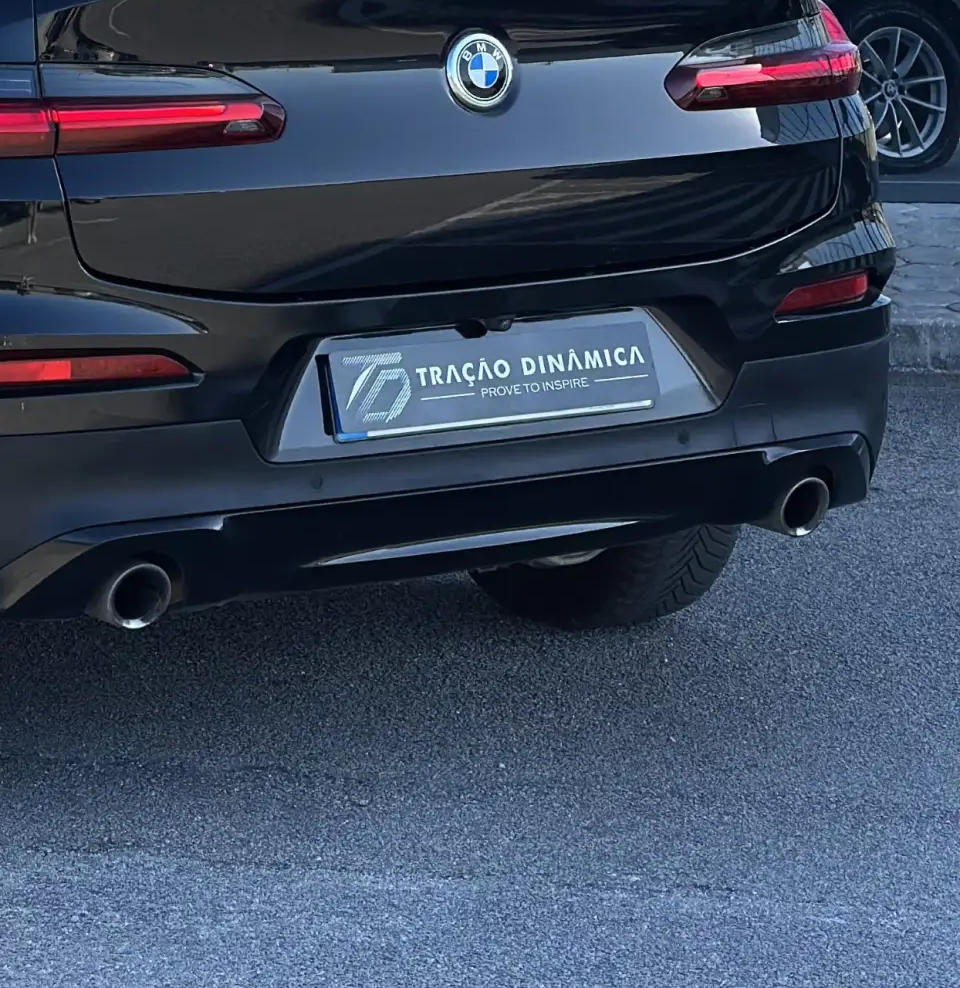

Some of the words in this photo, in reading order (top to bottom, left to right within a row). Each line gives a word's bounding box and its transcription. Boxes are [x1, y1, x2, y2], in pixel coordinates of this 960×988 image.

[461, 42, 503, 62] BMW
[415, 357, 511, 387] TRAÇÃO
[520, 345, 645, 376] DINÂMICA
[480, 383, 522, 398] PROVE
[522, 382, 541, 394] TO
[542, 376, 590, 393] INSPIRE
